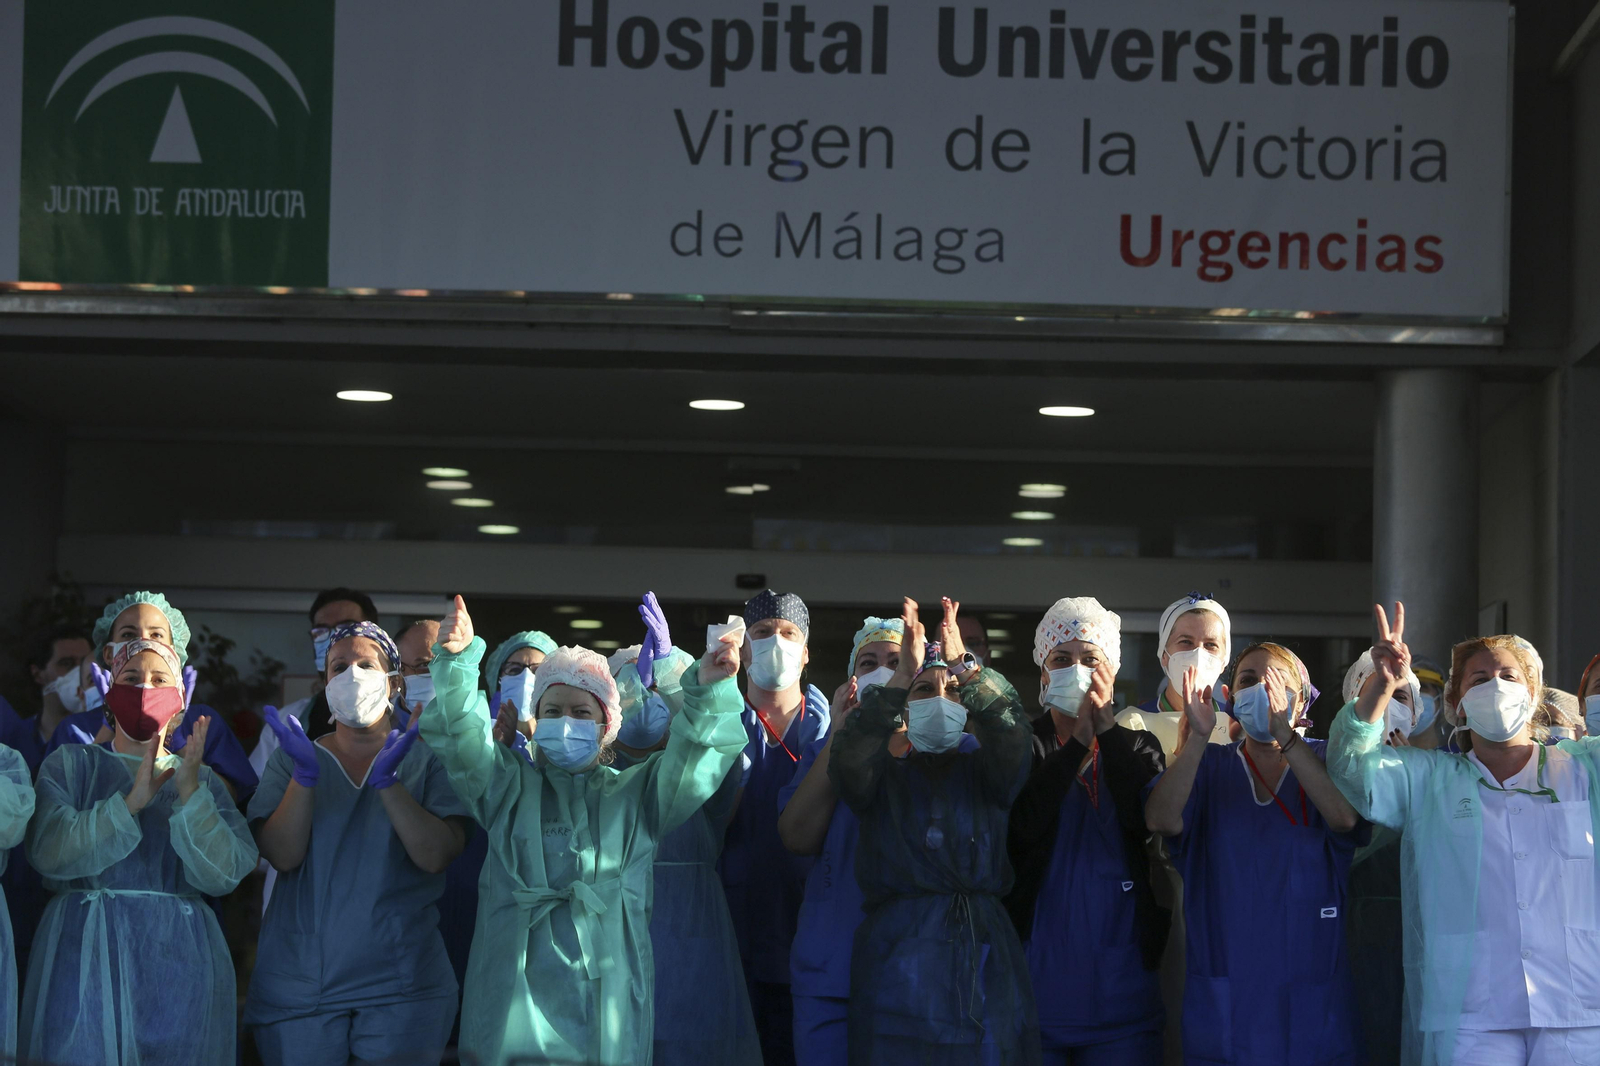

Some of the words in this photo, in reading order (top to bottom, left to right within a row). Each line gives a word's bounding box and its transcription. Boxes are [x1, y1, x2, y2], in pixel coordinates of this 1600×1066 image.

[557, 0, 889, 88] Hospital
[937, 6, 1450, 90] Universitario
[673, 108, 894, 182] Virgen
[944, 114, 1031, 173] de
[1082, 117, 1136, 176] la
[1185, 120, 1448, 183] Victoria
[43, 185, 121, 216] JUNTA
[133, 187, 165, 216] DE
[174, 188, 307, 219] ANDALUCIA
[670, 209, 744, 258] de
[775, 211, 1005, 275] Málaga
[1119, 213, 1444, 283] Urgencias
